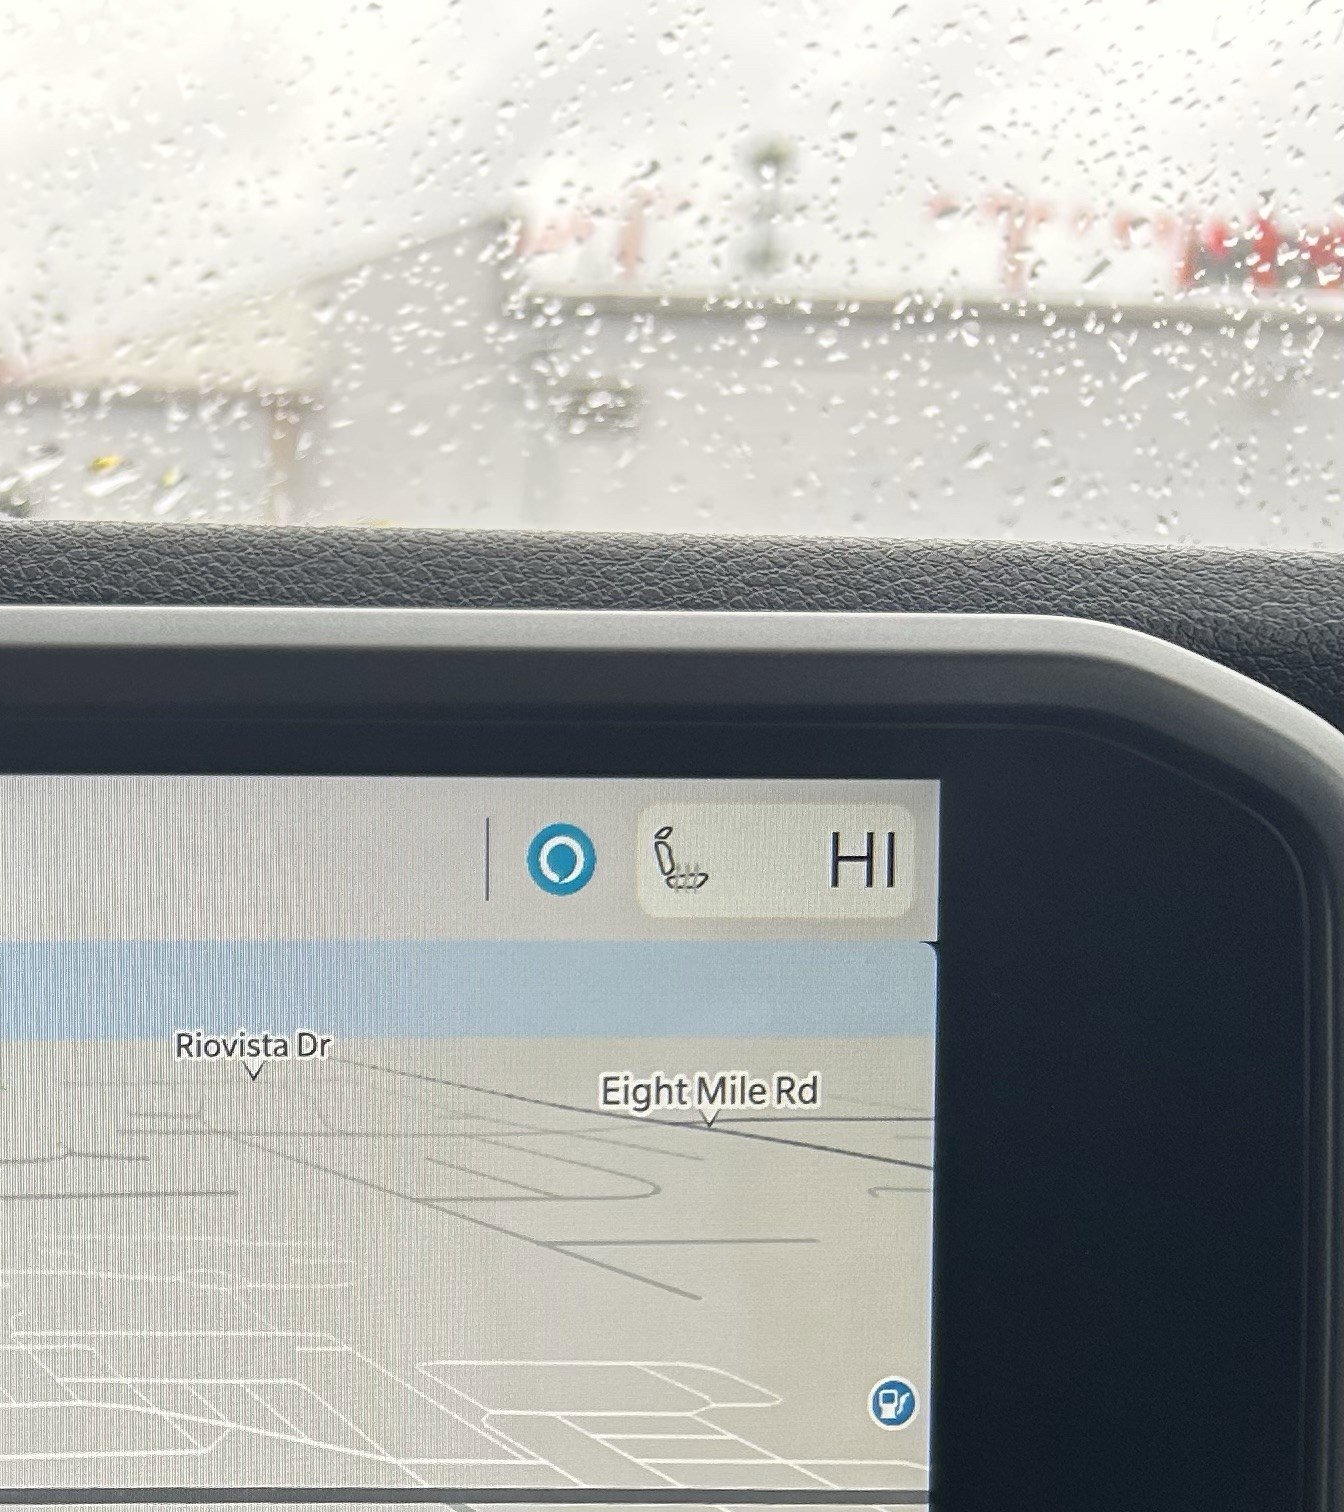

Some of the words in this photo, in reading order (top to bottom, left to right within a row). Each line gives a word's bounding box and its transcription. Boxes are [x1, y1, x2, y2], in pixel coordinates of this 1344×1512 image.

[831, 831, 896, 888] HI
[176, 1032, 288, 1058] Riovista
[297, 1032, 331, 1057] Dr
[600, 1075, 688, 1113] Eight
[697, 1075, 767, 1105] Mile
[776, 1075, 818, 1105] Rd
